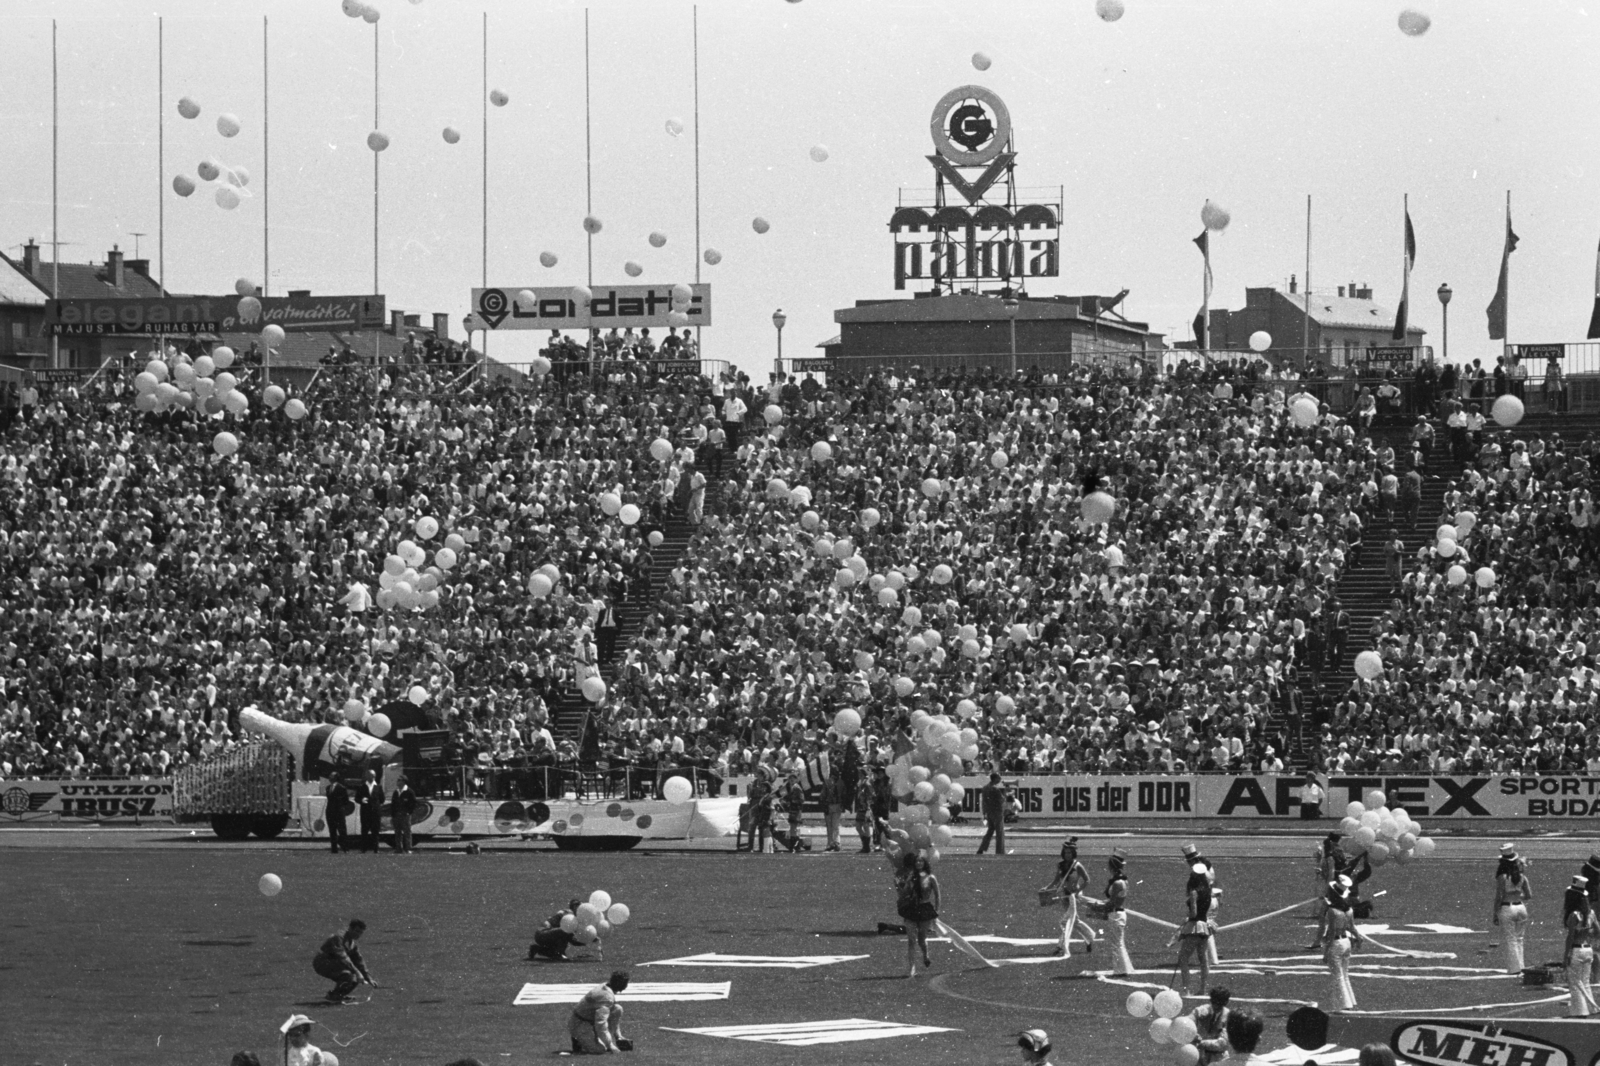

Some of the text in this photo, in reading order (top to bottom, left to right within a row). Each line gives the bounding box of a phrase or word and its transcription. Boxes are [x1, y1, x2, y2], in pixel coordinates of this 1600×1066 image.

[892, 222, 1058, 290] palma
[61, 299, 214, 331] elegant
[1052, 787, 1091, 812] aus
[1096, 781, 1131, 812] der
[1138, 781, 1192, 812] DDR
